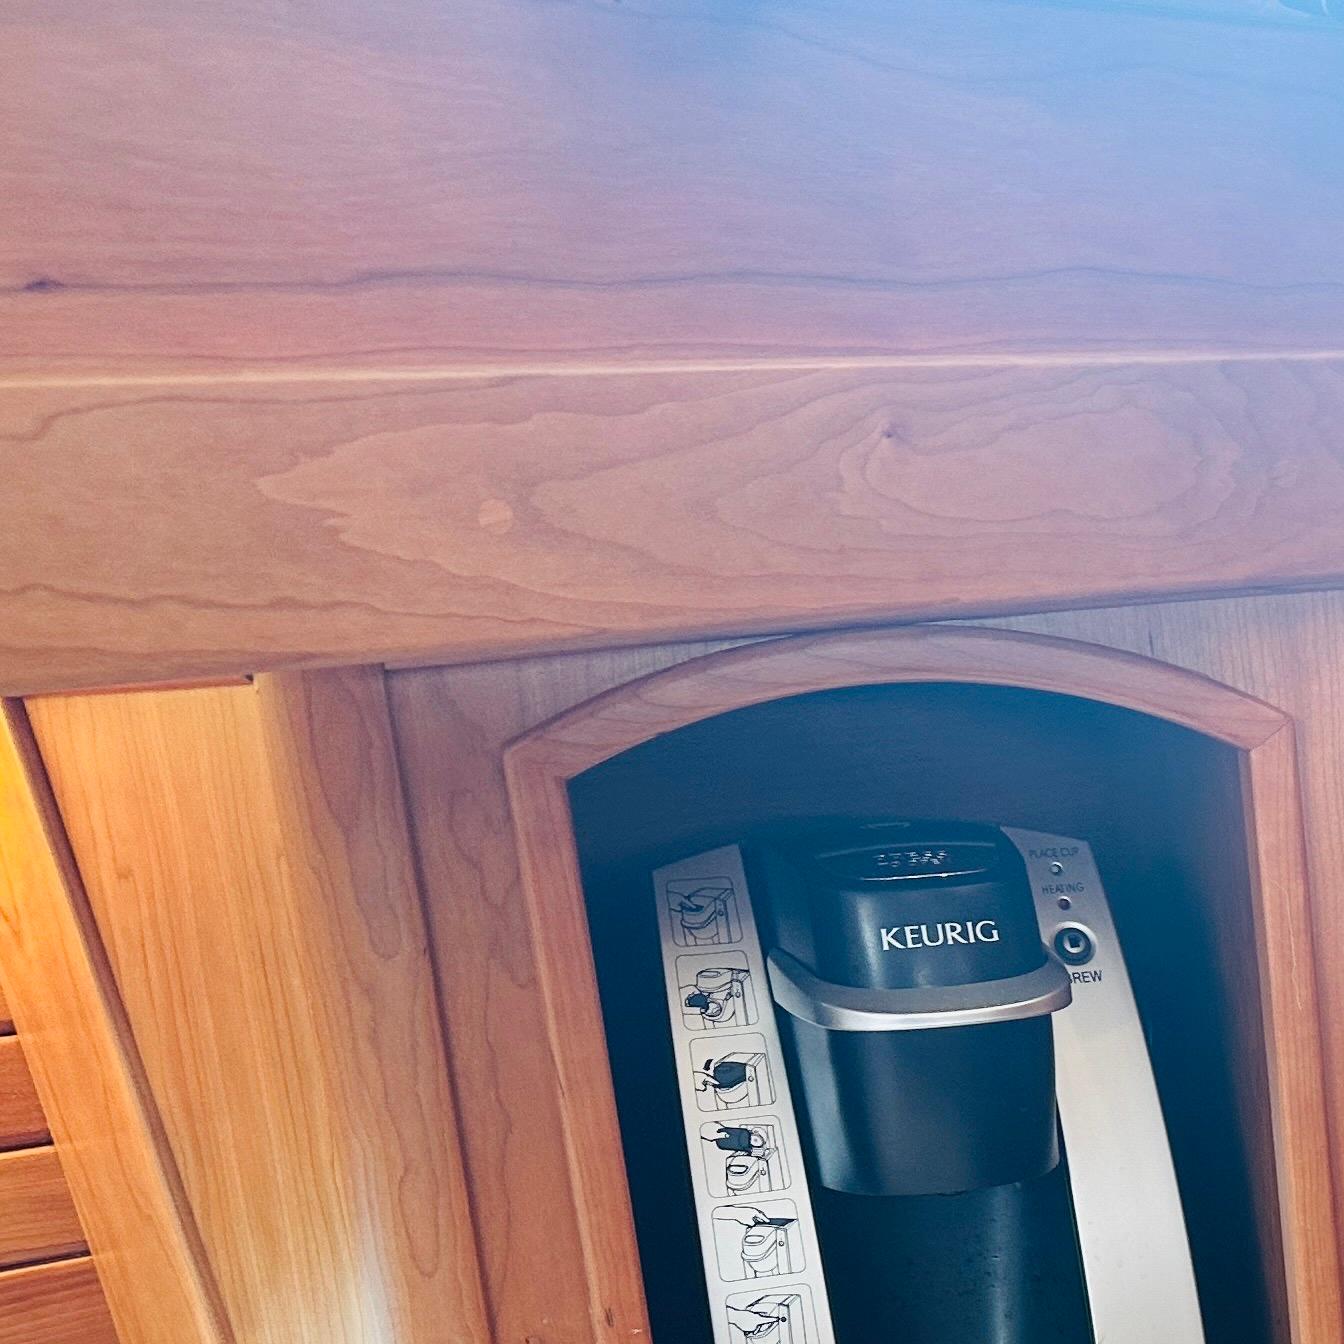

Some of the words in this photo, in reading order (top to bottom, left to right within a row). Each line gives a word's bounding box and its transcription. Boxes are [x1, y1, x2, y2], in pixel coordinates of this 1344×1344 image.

[1028, 848, 1058, 859] PLACE
[1060, 846, 1079, 857] CUP
[1042, 882, 1085, 895] HEATING
[880, 920, 1000, 951] KEURIG
